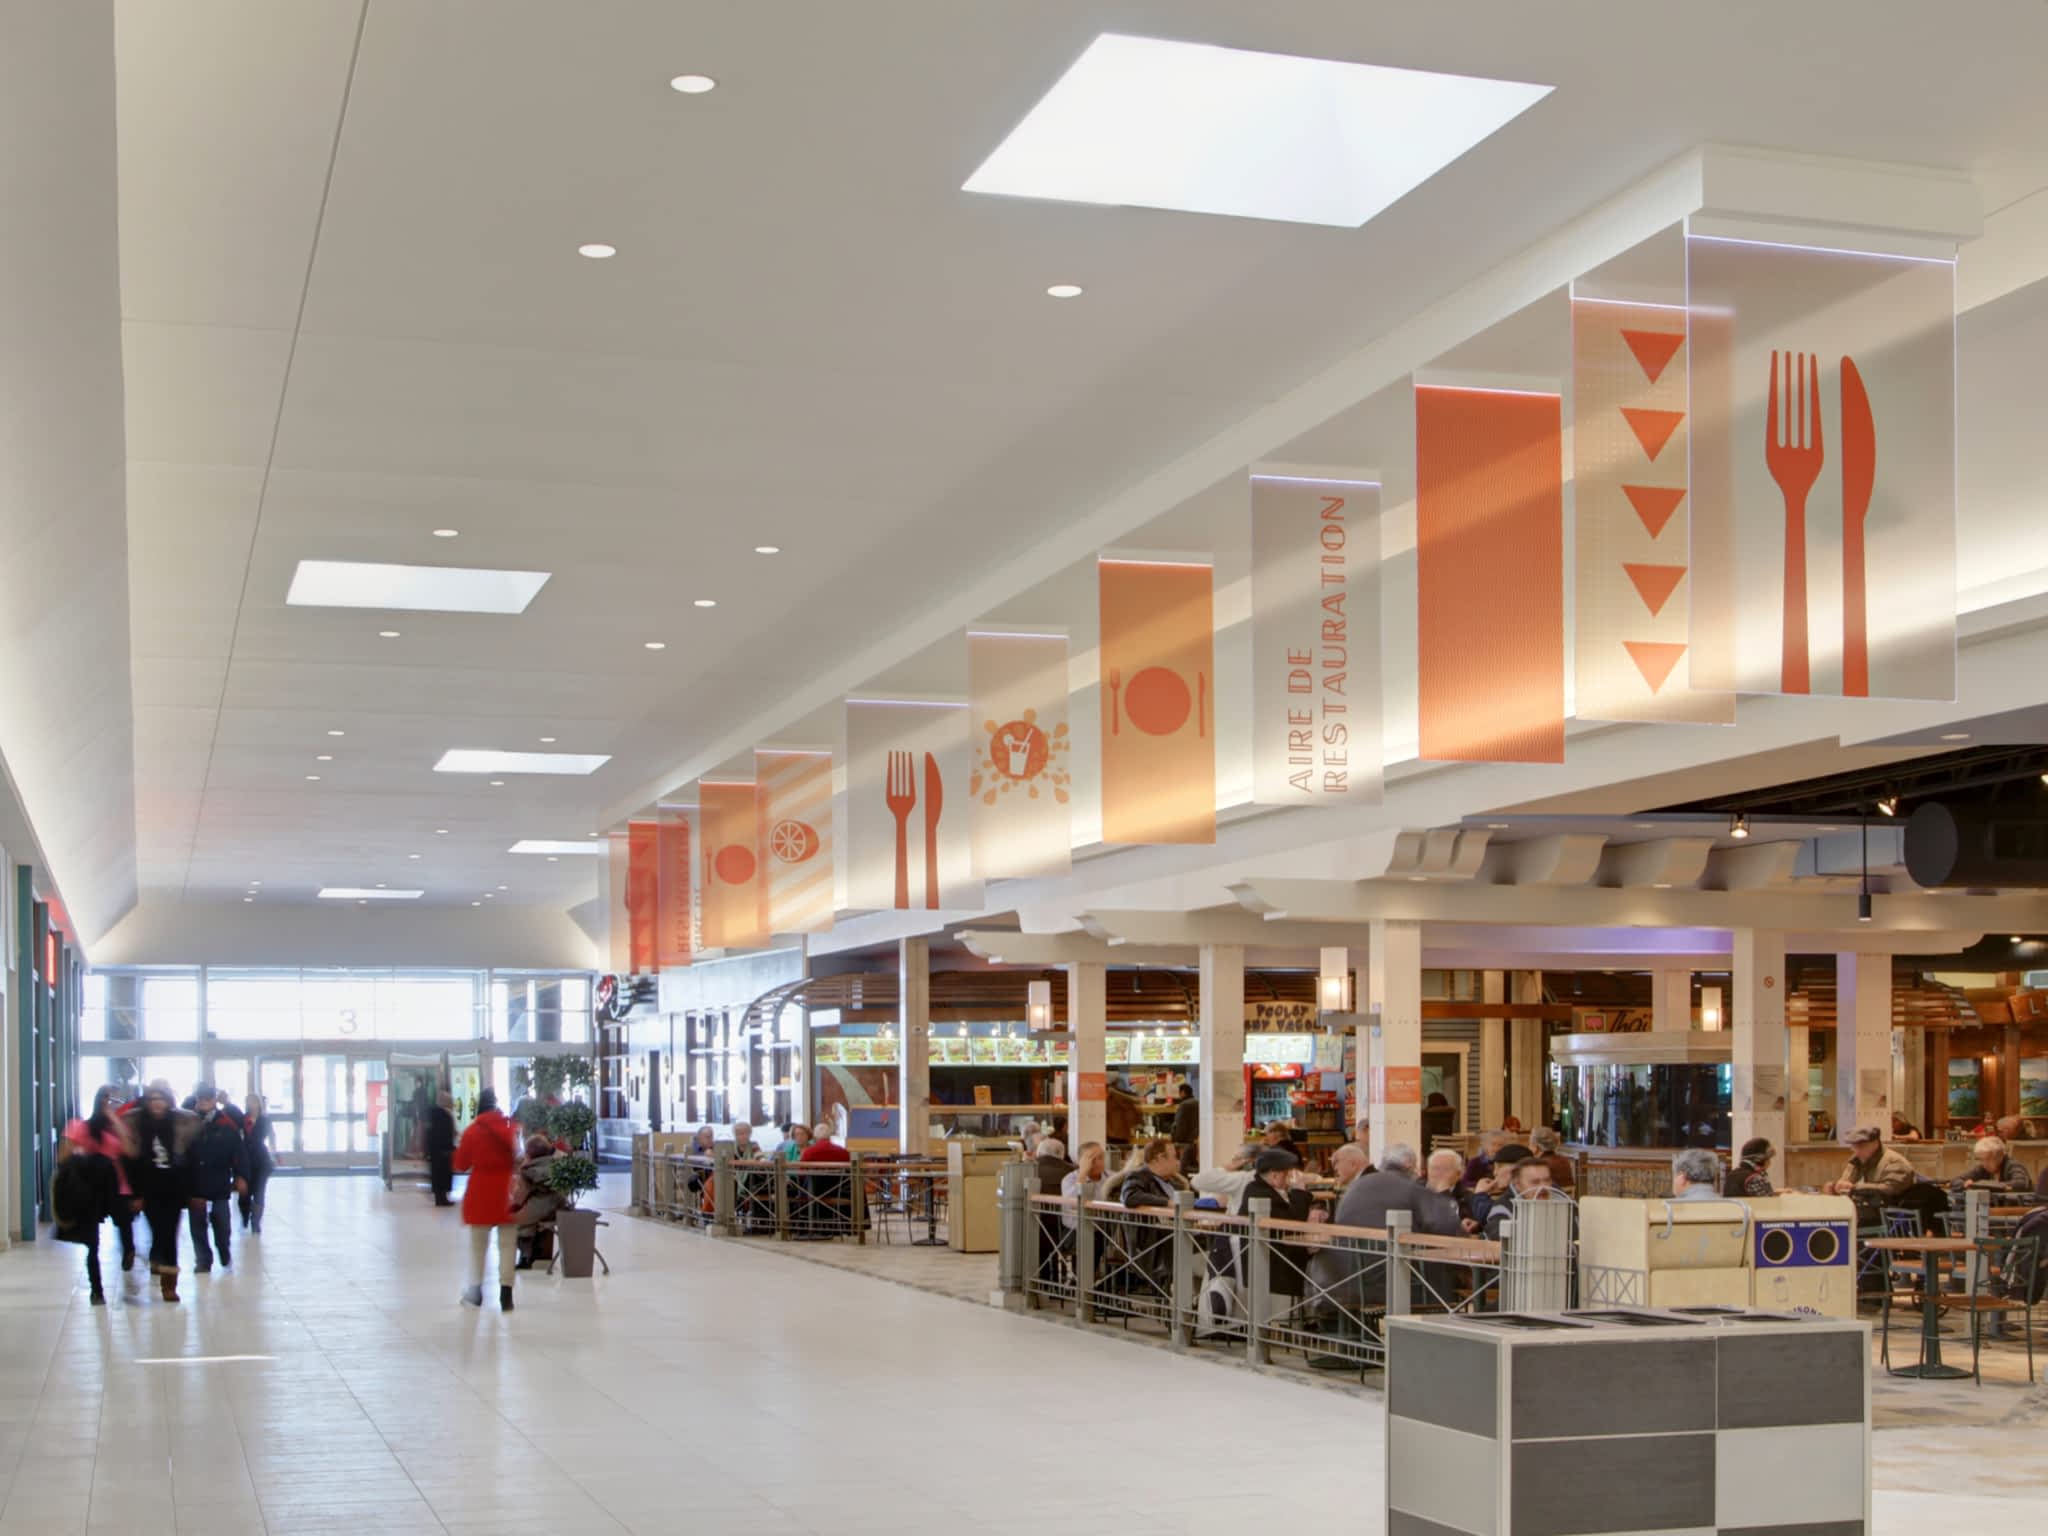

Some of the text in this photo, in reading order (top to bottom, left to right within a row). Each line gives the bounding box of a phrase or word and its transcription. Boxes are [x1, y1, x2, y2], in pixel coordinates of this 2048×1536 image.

[1320, 495, 1348, 794] RESTAURATION
[1288, 648, 1313, 794] AIRE DE
[338, 1008, 359, 1035] 3
